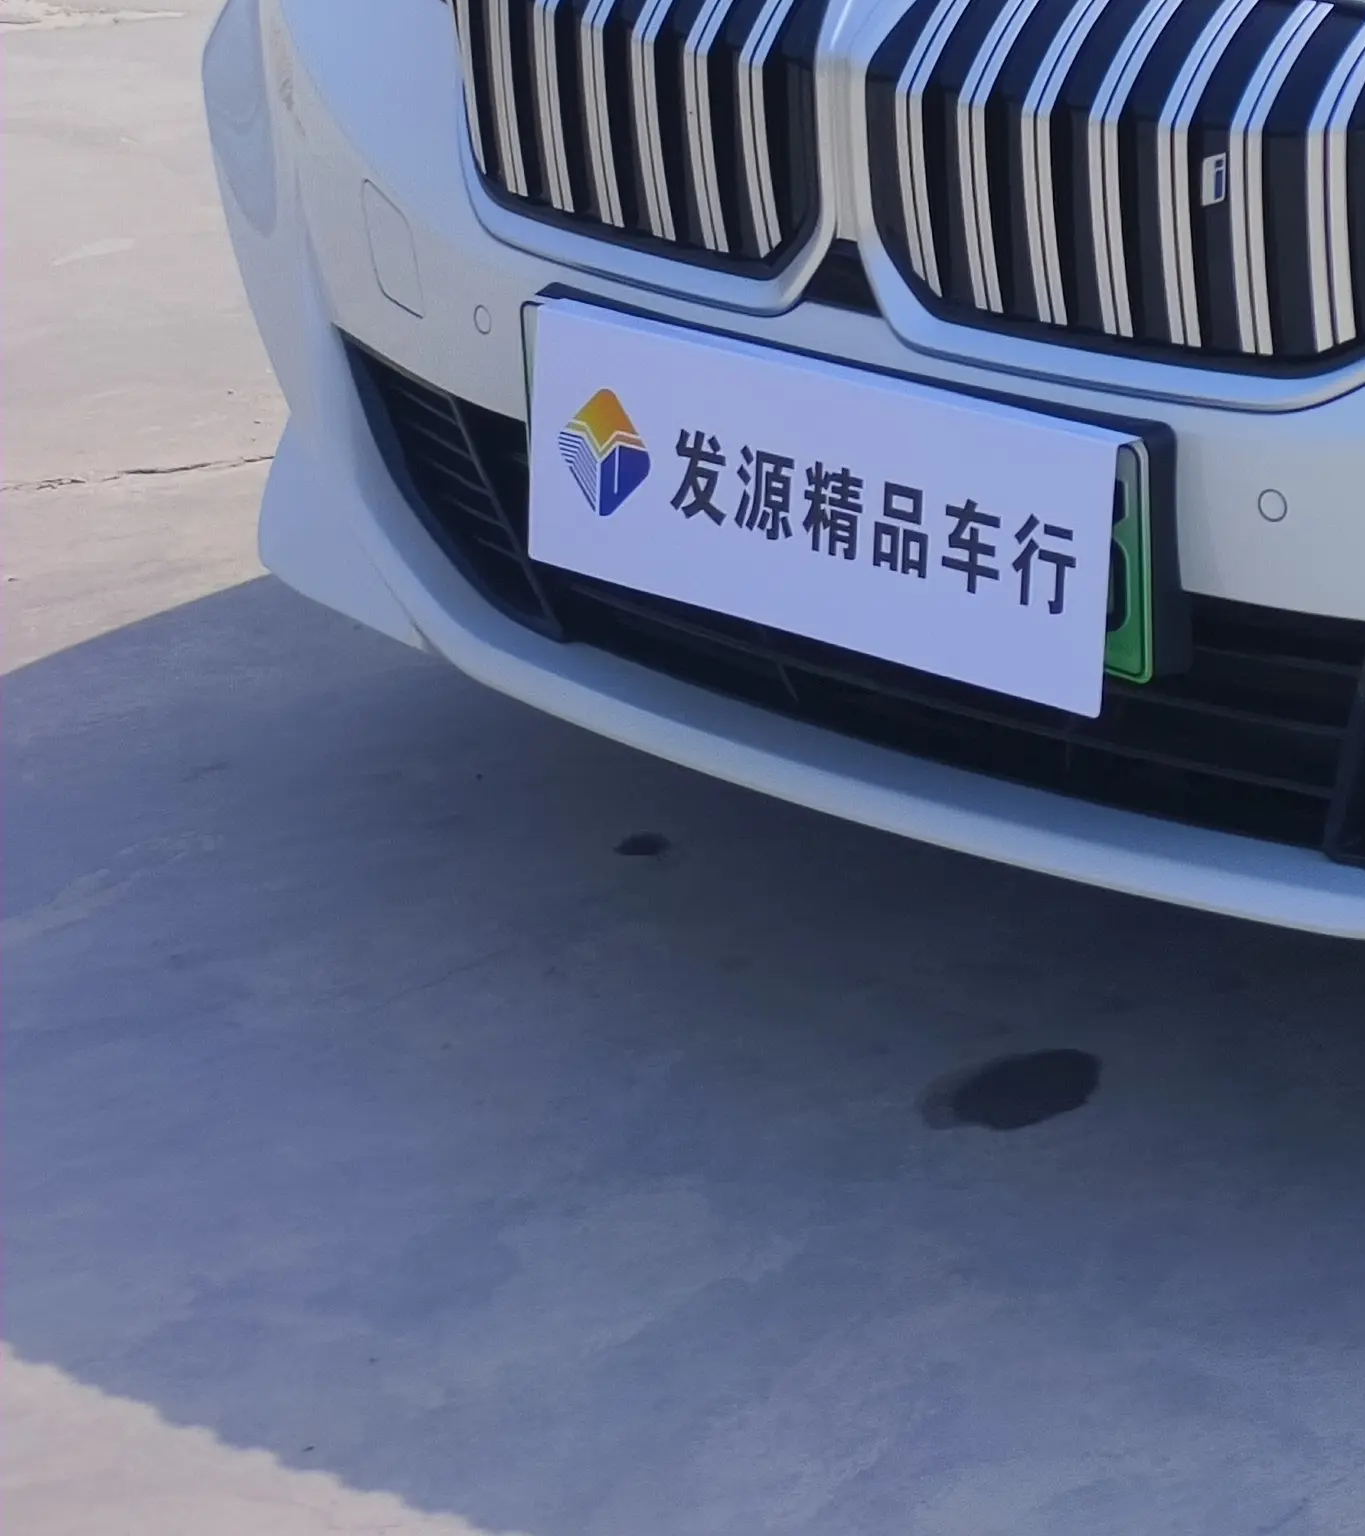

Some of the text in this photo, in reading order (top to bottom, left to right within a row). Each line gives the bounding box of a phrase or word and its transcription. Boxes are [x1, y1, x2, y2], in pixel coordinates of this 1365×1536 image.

[669, 427, 1078, 615] 发源精品车行
